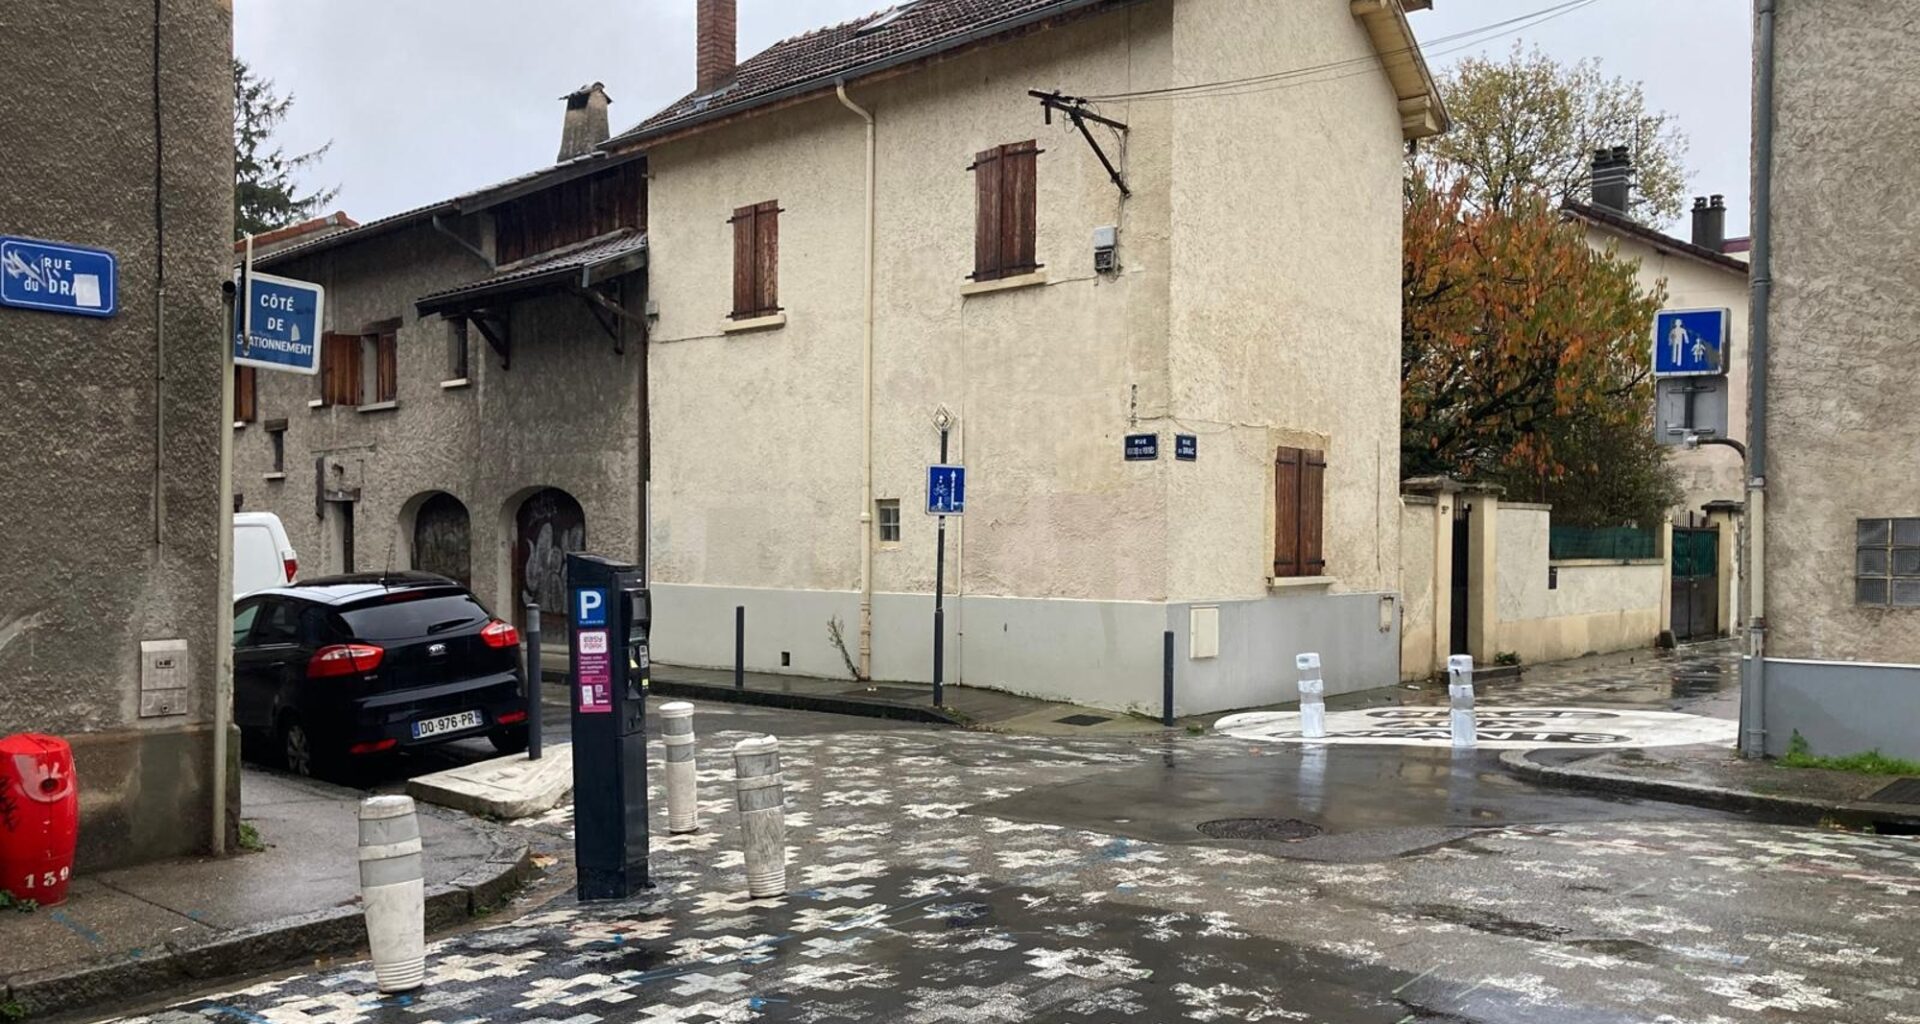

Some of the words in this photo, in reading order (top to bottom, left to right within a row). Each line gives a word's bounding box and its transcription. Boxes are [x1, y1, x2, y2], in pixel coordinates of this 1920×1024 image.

[44, 257, 72, 271] RUE
[24, 277, 39, 292] du
[260, 292, 294, 312] CÔTÉ
[267, 317, 284, 332] DE
[236, 333, 313, 356] SATIONNEMENT
[580, 590, 602, 620] P
